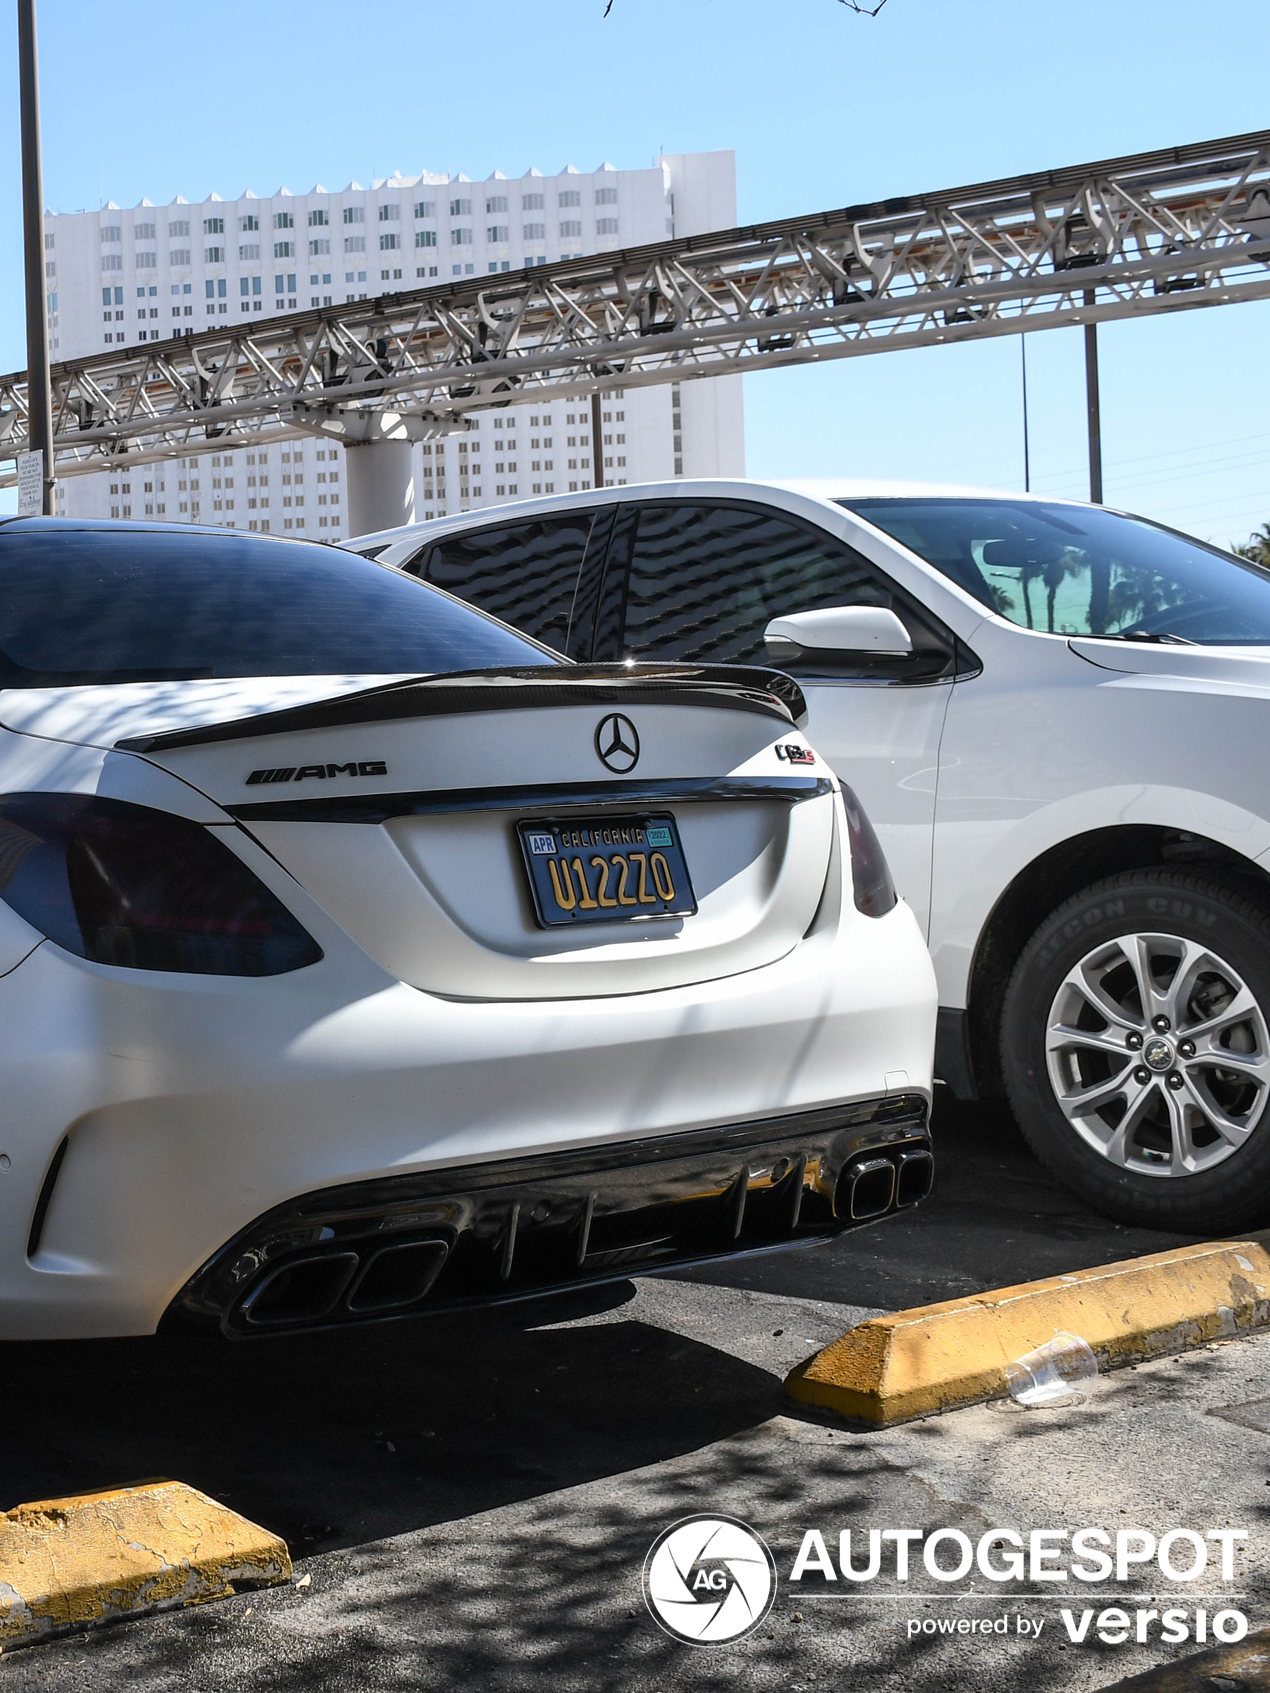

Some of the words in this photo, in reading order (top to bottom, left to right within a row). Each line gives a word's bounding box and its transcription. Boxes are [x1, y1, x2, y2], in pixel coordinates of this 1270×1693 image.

[294, 760, 388, 781] AMG
[533, 836, 554, 852] APR
[561, 828, 645, 848] CALIFORNIA
[650, 831, 667, 840] 2022
